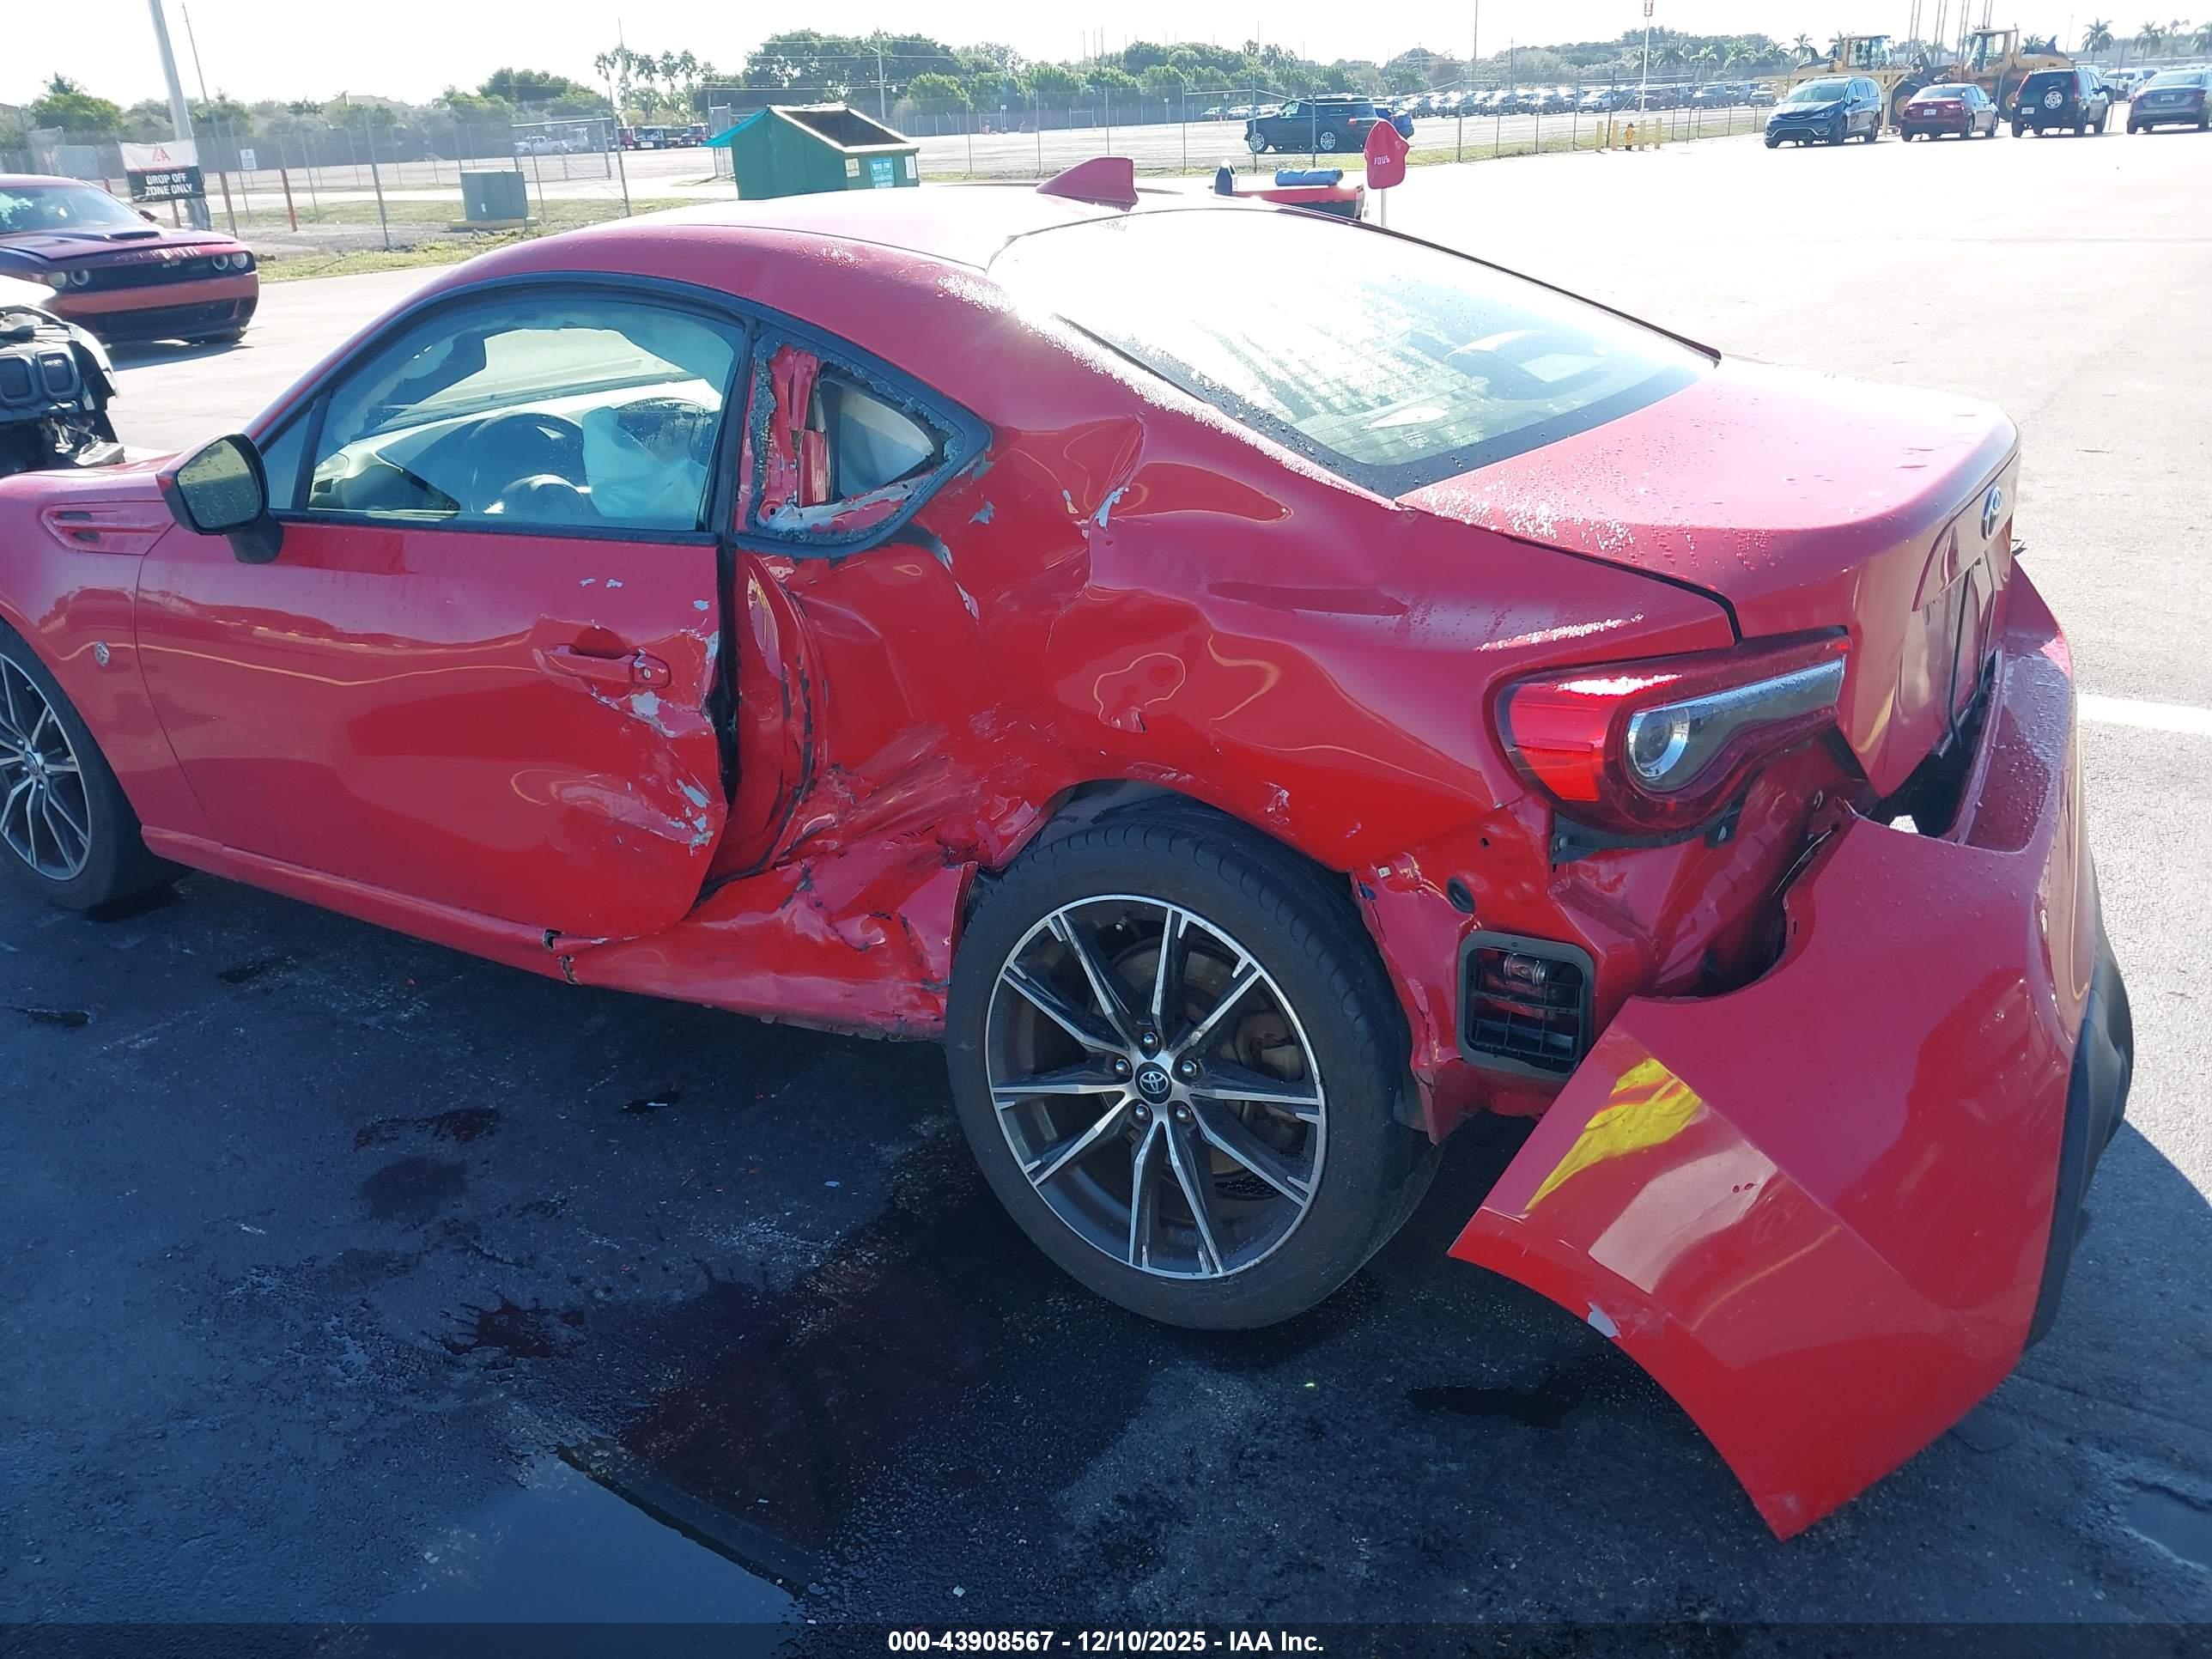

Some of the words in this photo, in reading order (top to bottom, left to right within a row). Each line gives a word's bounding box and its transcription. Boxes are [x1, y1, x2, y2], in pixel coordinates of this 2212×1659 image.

[145, 173, 170, 185] DROP
[172, 173, 187, 183] OFF
[144, 185, 170, 196] ZONE
[171, 183, 192, 194] ONLY
